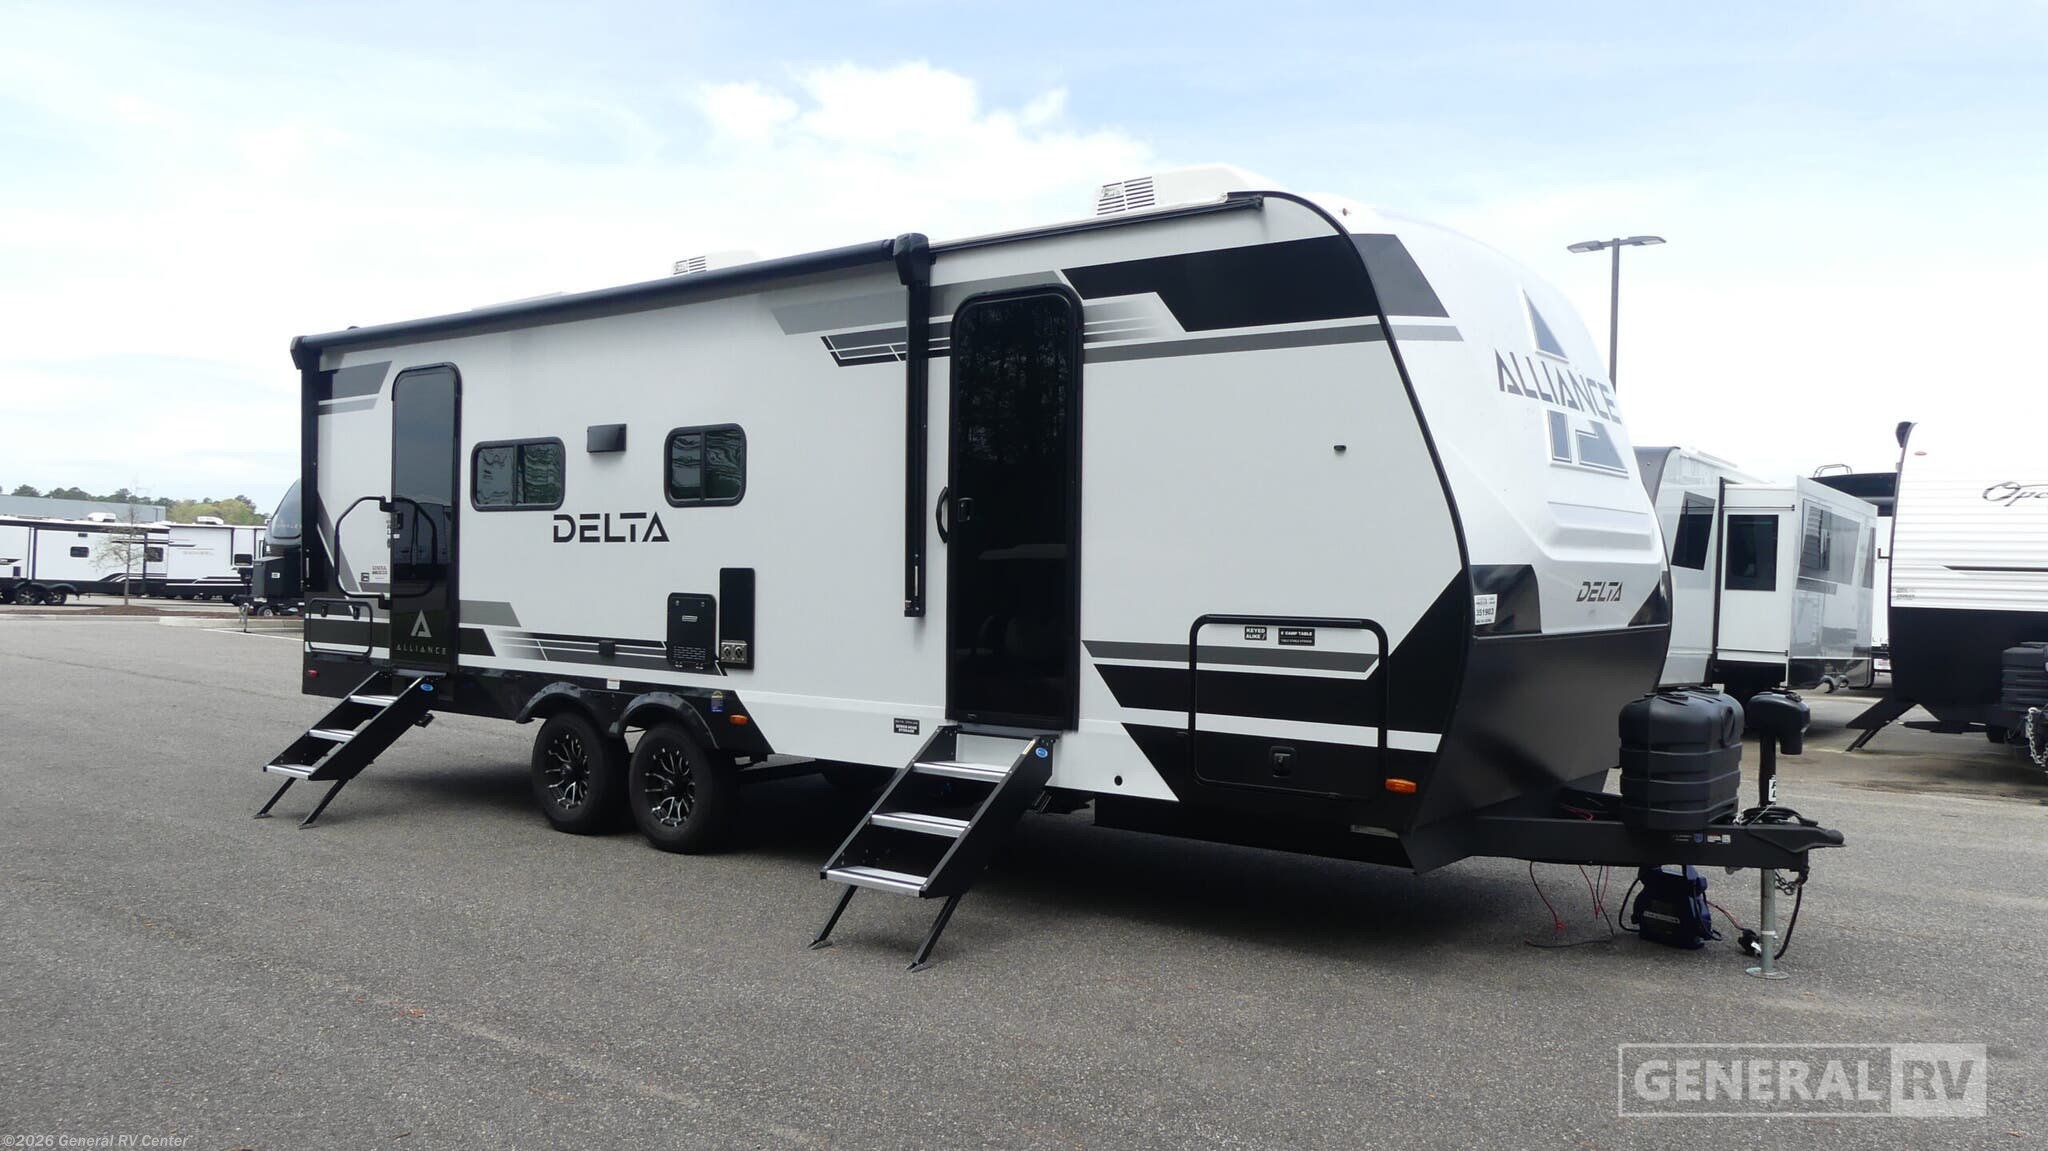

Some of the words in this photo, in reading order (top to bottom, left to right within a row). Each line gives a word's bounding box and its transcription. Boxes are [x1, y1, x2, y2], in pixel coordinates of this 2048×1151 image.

[1494, 348, 1622, 425] ALLIANCE
[553, 512, 670, 543] DELTA
[1576, 581, 1623, 602] DELTA
[396, 643, 447, 655] ALLIANCE
